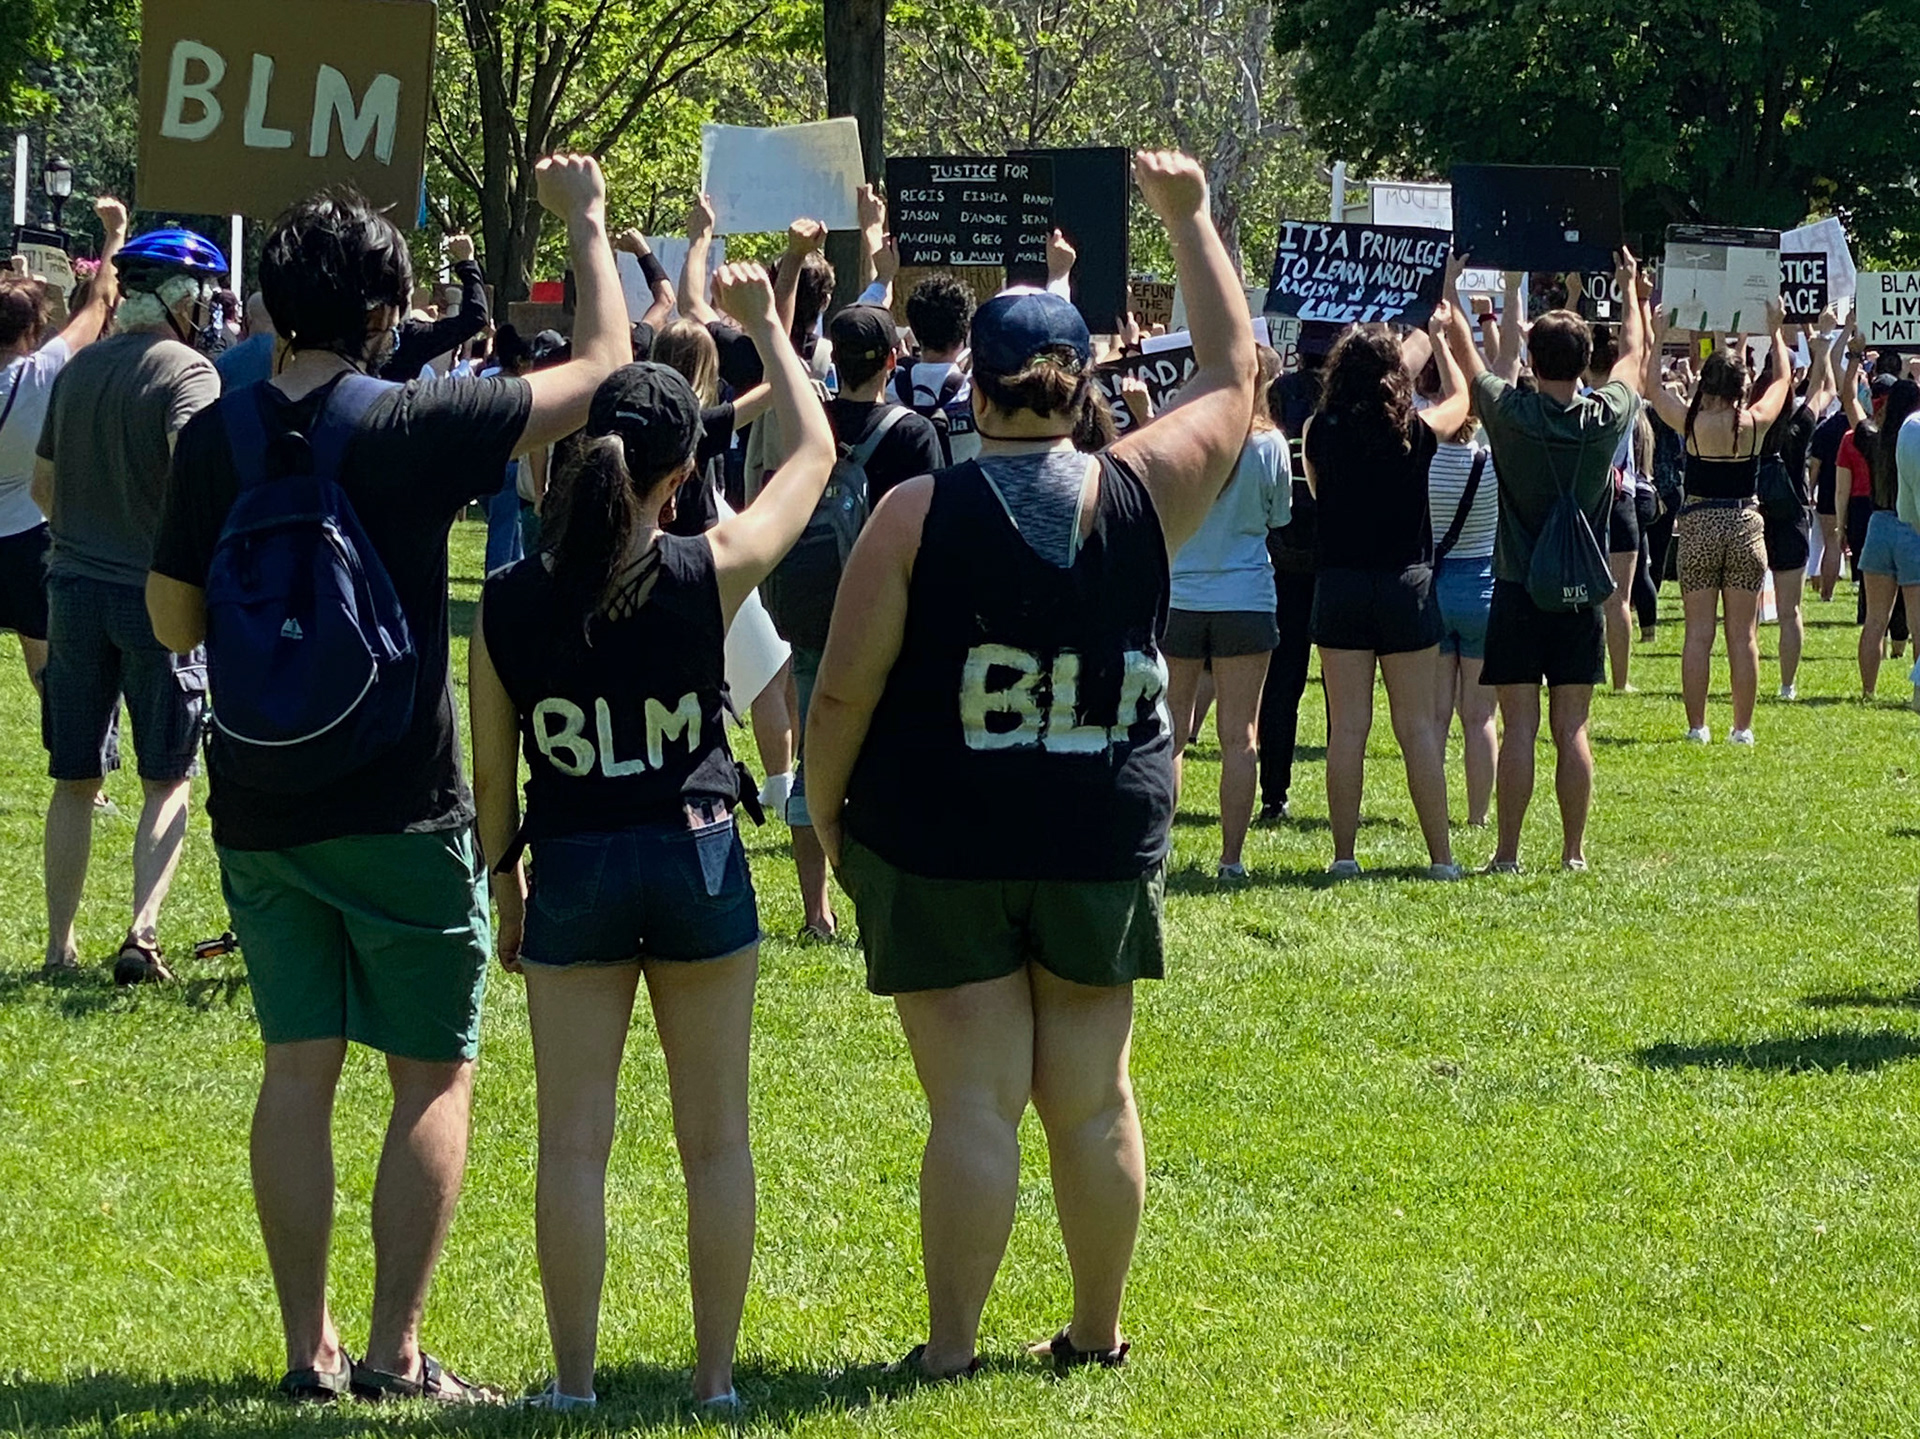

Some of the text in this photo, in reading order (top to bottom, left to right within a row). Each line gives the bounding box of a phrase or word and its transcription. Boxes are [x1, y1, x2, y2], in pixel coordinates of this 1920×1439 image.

[160, 39, 401, 166] BLM
[930, 164, 1029, 179] JUSTICE FOR
[900, 189, 1054, 206] REGIS EISHIA RANDY
[901, 209, 1048, 225] JASON D'ANDRE SEAN
[972, 233, 1002, 245] GREG
[913, 251, 942, 262] AND
[950, 252, 963, 262] SO
[1014, 253, 1046, 262] MORE
[1329, 230, 1349, 258] A
[1360, 231, 1450, 268] PRIVILEGE
[1281, 252, 1434, 292] TO LEARN ABOUT
[1276, 275, 1340, 299] RACISM
[1373, 291, 1418, 306] NOT
[1881, 274, 1920, 293] BLA
[1137, 298, 1163, 310] THE
[1882, 297, 1920, 316] LIV
[532, 692, 702, 778] BLM
